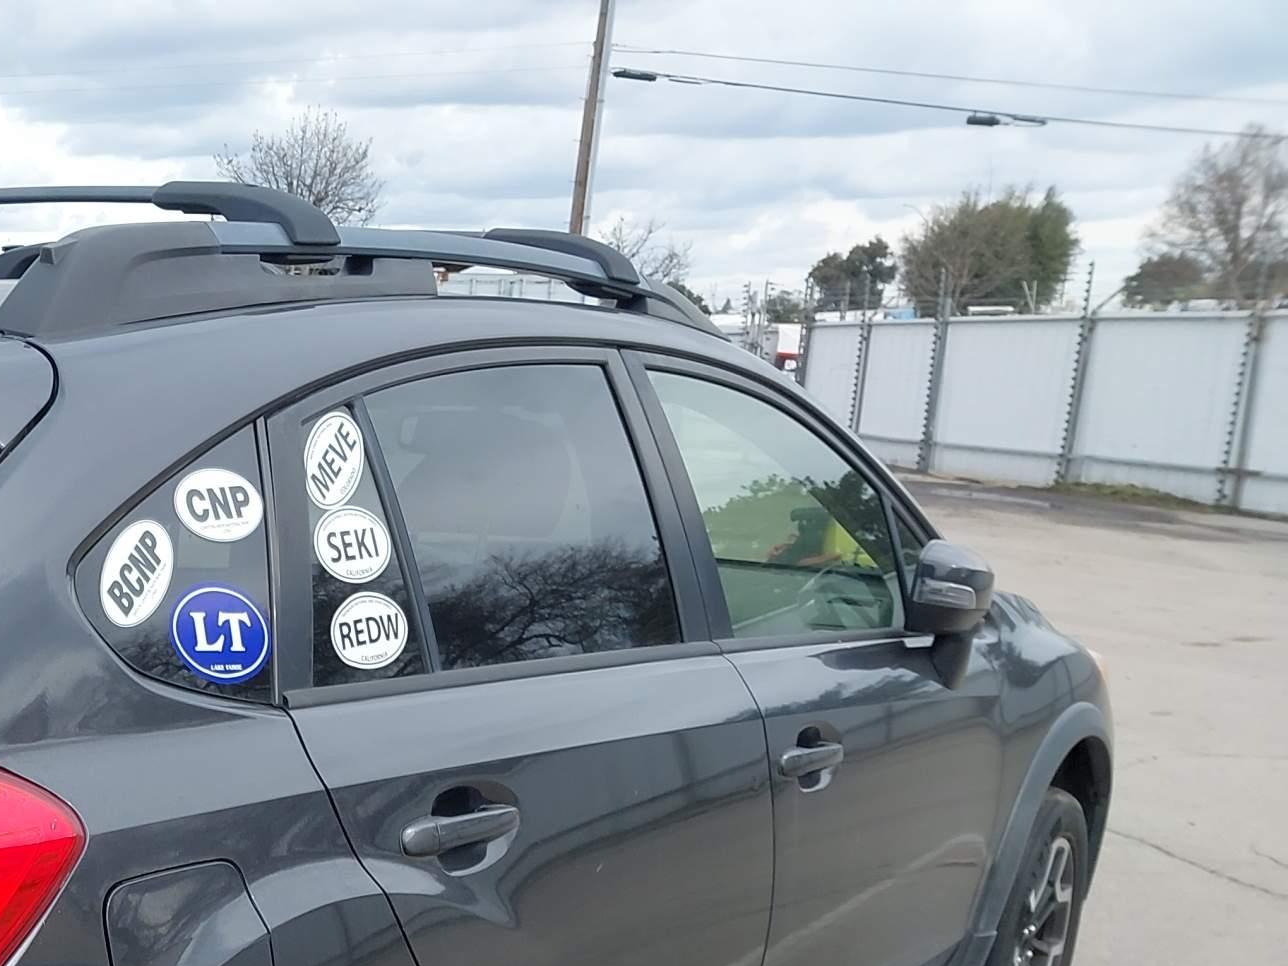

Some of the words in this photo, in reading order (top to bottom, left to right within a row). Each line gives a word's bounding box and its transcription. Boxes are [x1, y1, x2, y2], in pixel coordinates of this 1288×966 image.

[310, 421, 357, 501] MEVE
[185, 485, 250, 523] CNP
[326, 527, 380, 563] SEKI
[106, 529, 162, 618] BCNP
[189, 610, 252, 652] LT
[338, 611, 399, 651] REDW
